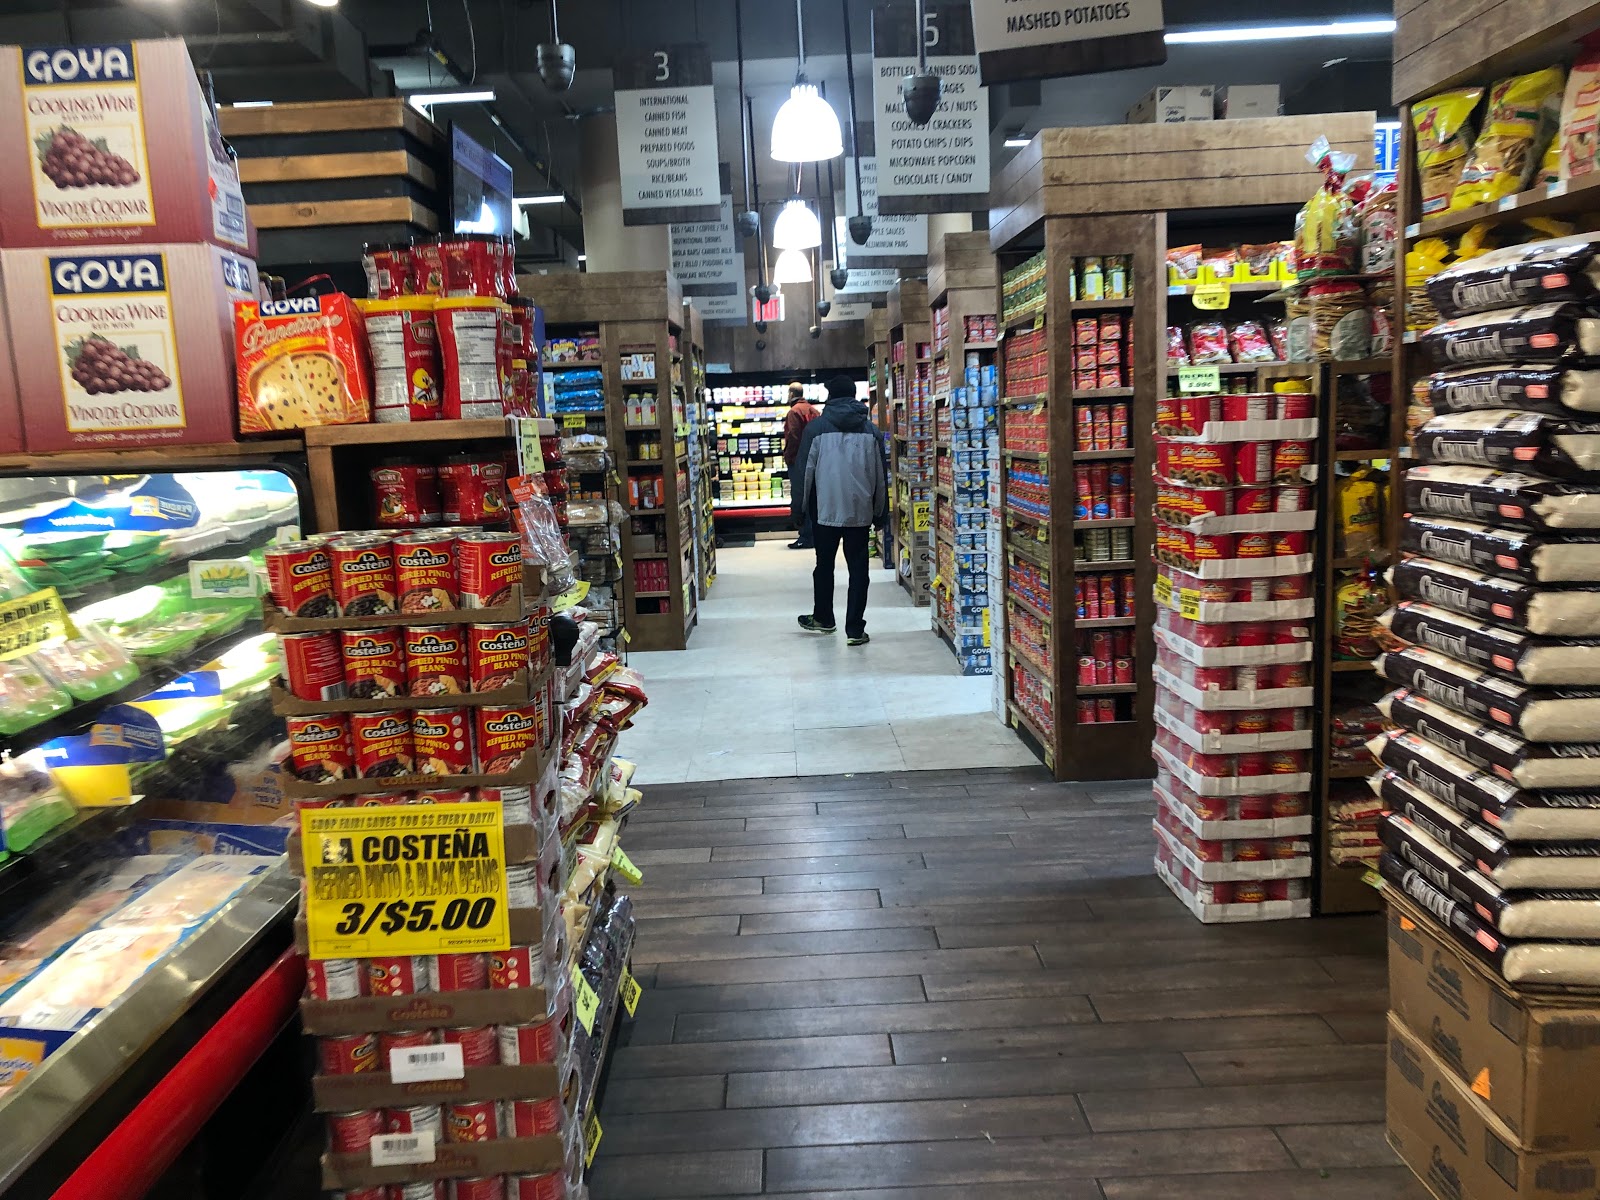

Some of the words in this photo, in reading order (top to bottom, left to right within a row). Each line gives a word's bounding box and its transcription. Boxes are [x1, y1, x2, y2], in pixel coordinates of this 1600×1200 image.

[1006, 11, 1061, 33] MASHED
[1065, 1, 1131, 26] POTATOES
[923, 13, 940, 47] 5
[27, 46, 130, 84] GOYA
[653, 51, 670, 81] 3
[880, 65, 916, 77] BOTTLED
[639, 94, 689, 107] INTERNATIONAL
[956, 99, 978, 111] NUTS
[644, 111, 670, 122] CANNED
[671, 110, 686, 121] FISH
[932, 118, 973, 131] CRACKERS
[644, 127, 671, 138] CANNED
[671, 126, 688, 137] MEAT
[640, 142, 672, 154] PREPARED
[673, 141, 695, 152] FOODS
[891, 138, 922, 150] POTATO
[923, 137, 947, 149] CHIPS
[954, 136, 973, 148] DIPS
[646, 157, 691, 170] SOUPS/BROTH
[889, 156, 936, 168] MICROWAVE
[937, 154, 976, 166] POPCORN
[651, 172, 688, 184] RICE/BEANS
[893, 173, 939, 186] CHOCOLATE
[946, 172, 973, 184] CANDY
[638, 189, 664, 200] CANNED
[664, 187, 703, 199] VEGETABLES
[55, 257, 160, 293] GOYA
[261, 297, 318, 316] GOYA
[57, 305, 126, 323] COOKING
[128, 303, 166, 320] WINE
[122, 402, 179, 419] COCINAR
[313, 554, 325, 562] La
[363, 554, 376, 562] La
[416, 550, 429, 558] La
[343, 560, 390, 572] Costeña
[400, 555, 446, 566] Costeña
[428, 569, 451, 579] PINTO
[490, 566, 517, 581] REFRIED
[358, 581, 385, 592] BEANS
[411, 577, 439, 586] BEANS
[424, 637, 436, 645] La
[481, 638, 526, 650] Costeña
[346, 645, 391, 656] Costeña
[409, 642, 454, 653] Costeña
[371, 659, 398, 668] BLACK
[435, 656, 459, 666] PINTO
[480, 653, 510, 667] REFRIED
[510, 652, 529, 661] PINTO
[493, 661, 519, 670] BEANS
[356, 667, 384, 676] BEANS
[419, 664, 446, 673] BEANS
[383, 720, 396, 728] La
[507, 715, 519, 723] La
[306, 726, 320, 734] La
[364, 723, 410, 738] Costeña
[489, 719, 533, 732] Costeña
[293, 730, 338, 742] Costeña
[486, 734, 516, 748] REFRIED
[517, 733, 536, 741] PINTO
[425, 739, 451, 750] PINTO
[501, 741, 526, 751] BEANS
[303, 752, 332, 762] BEANS
[378, 746, 405, 757] BEANS
[311, 818, 338, 831] SHOP
[366, 815, 397, 829] SAVES
[400, 814, 419, 827] YOU
[436, 813, 468, 825] EVERY
[322, 837, 354, 864] LA
[362, 828, 490, 863] COSTEÑA
[364, 863, 401, 898] PINTO
[416, 860, 458, 897] BLACK
[458, 858, 500, 895] BEANS
[335, 897, 497, 937] 3/$5.00
